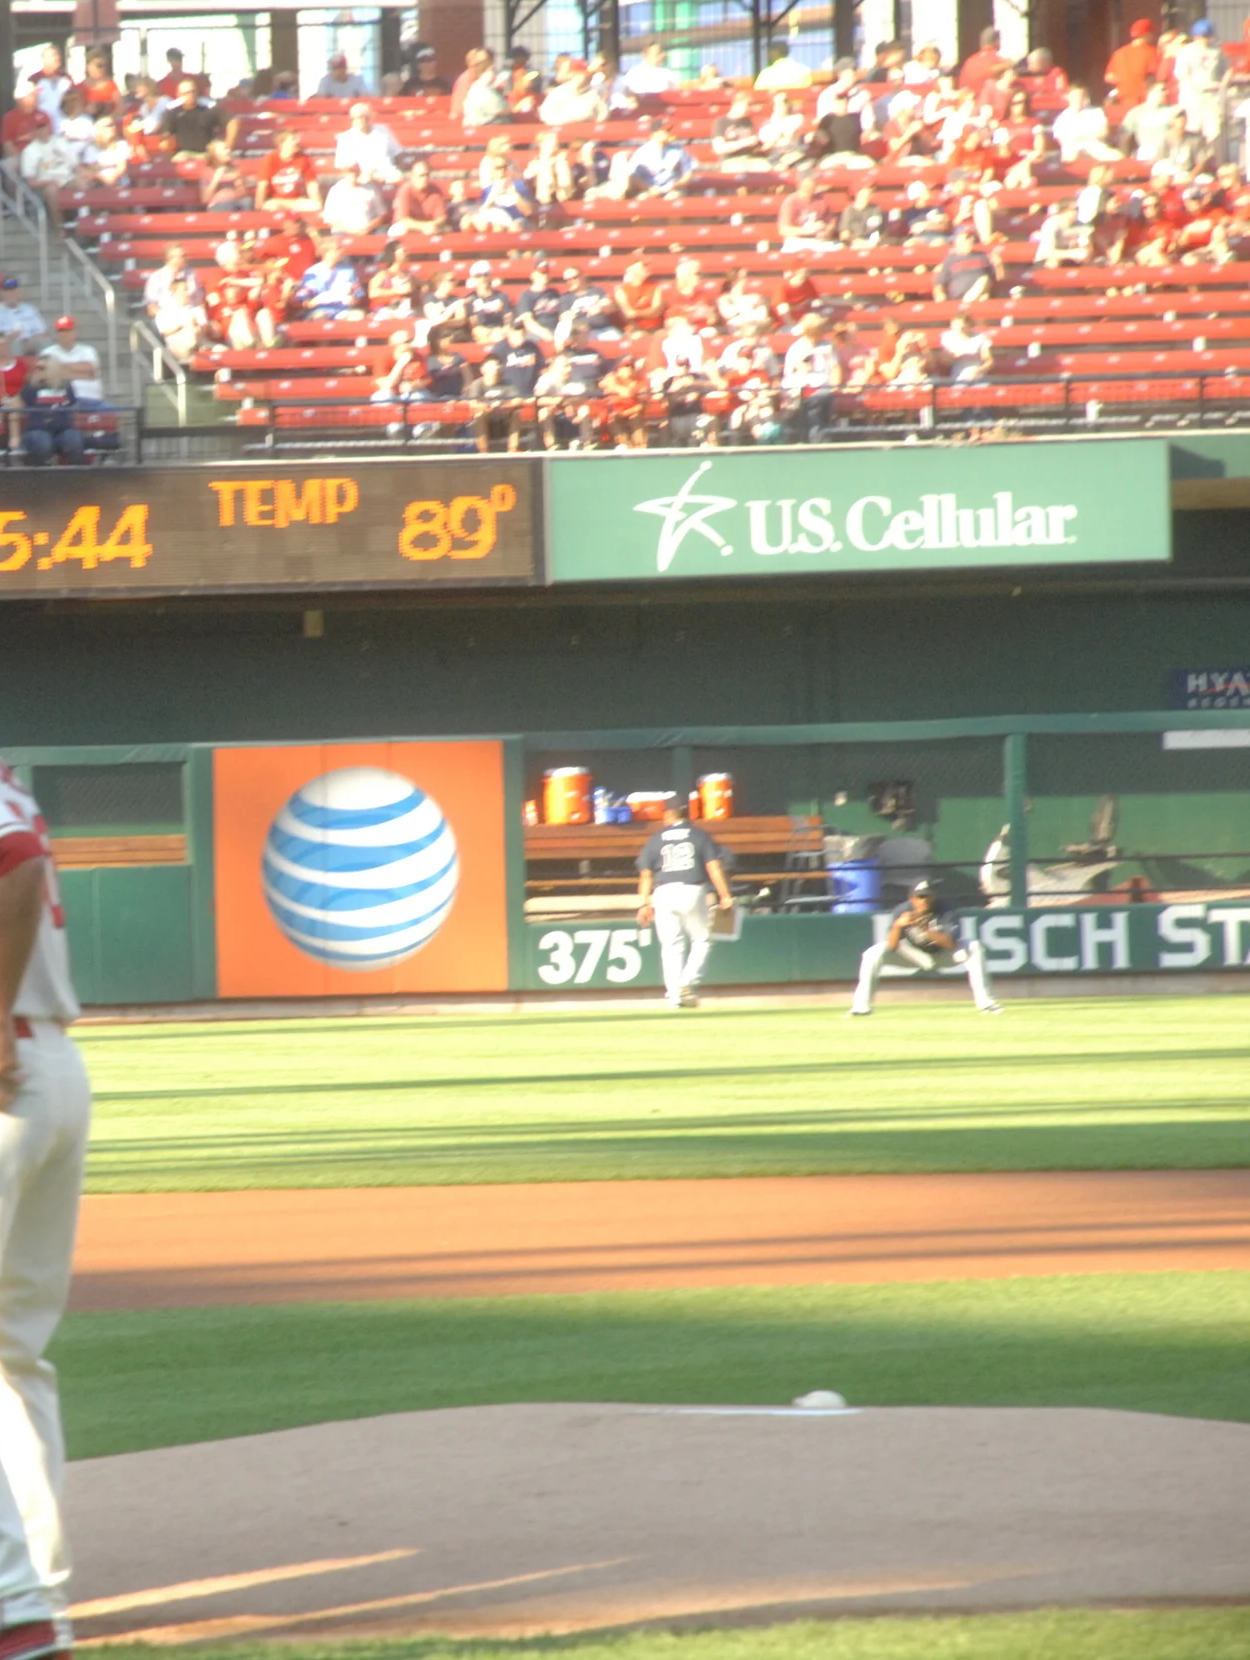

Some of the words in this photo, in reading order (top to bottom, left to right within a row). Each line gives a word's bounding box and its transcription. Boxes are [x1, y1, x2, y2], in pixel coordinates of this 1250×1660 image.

[208, 477, 359, 528] TEMP
[745, 497, 843, 555] U.S.
[846, 491, 1079, 551] Cellular
[1187, 671, 1250, 697] HYA
